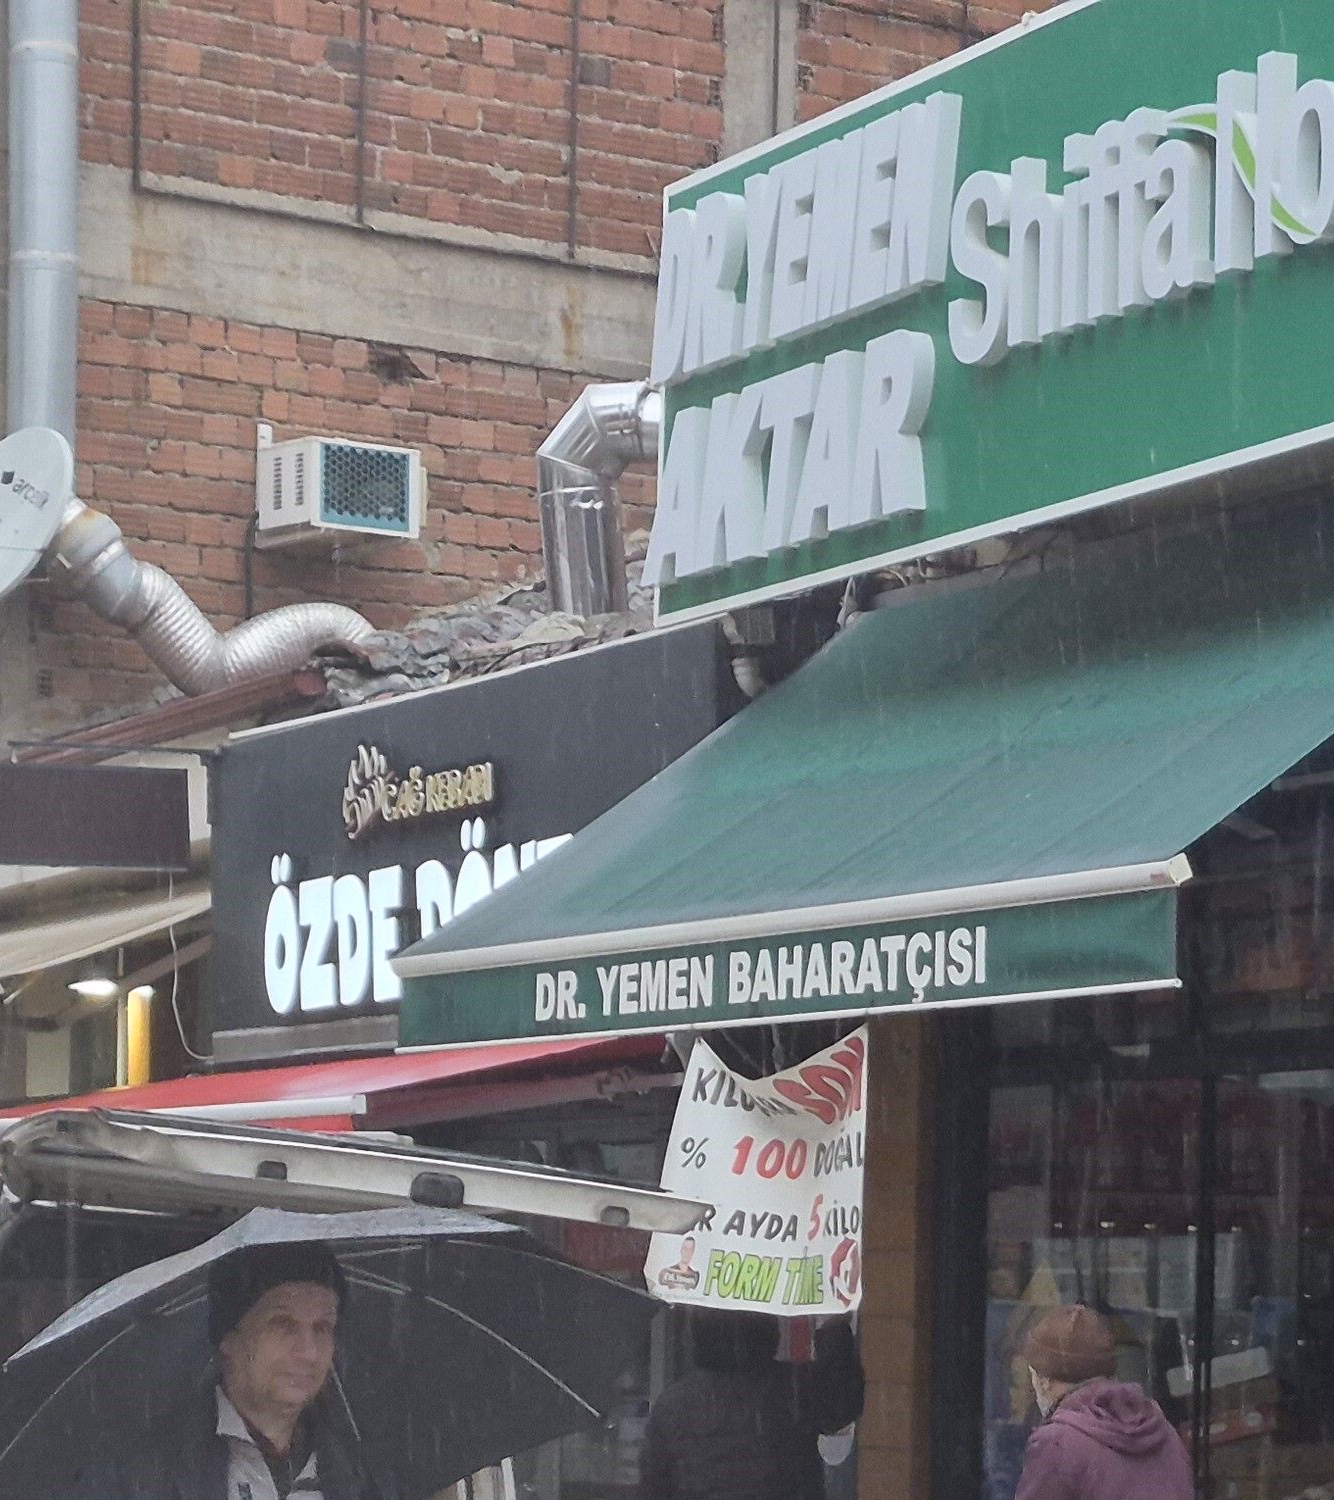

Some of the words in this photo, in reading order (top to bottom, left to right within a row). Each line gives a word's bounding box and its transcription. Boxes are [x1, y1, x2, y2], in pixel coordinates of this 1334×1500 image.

[640, 328, 935, 588] AKTAR
[265, 852, 404, 1014] ÖZDE
[535, 970, 586, 1021] DR.
[597, 955, 714, 1017] YEMEN
[729, 925, 987, 1005] BAHARATÇISI
[680, 1137, 709, 1169] %
[731, 1135, 808, 1180] 100
[723, 1210, 798, 1243] AYDA
[807, 1194, 824, 1241] 5
[704, 1248, 781, 1304] FORM
